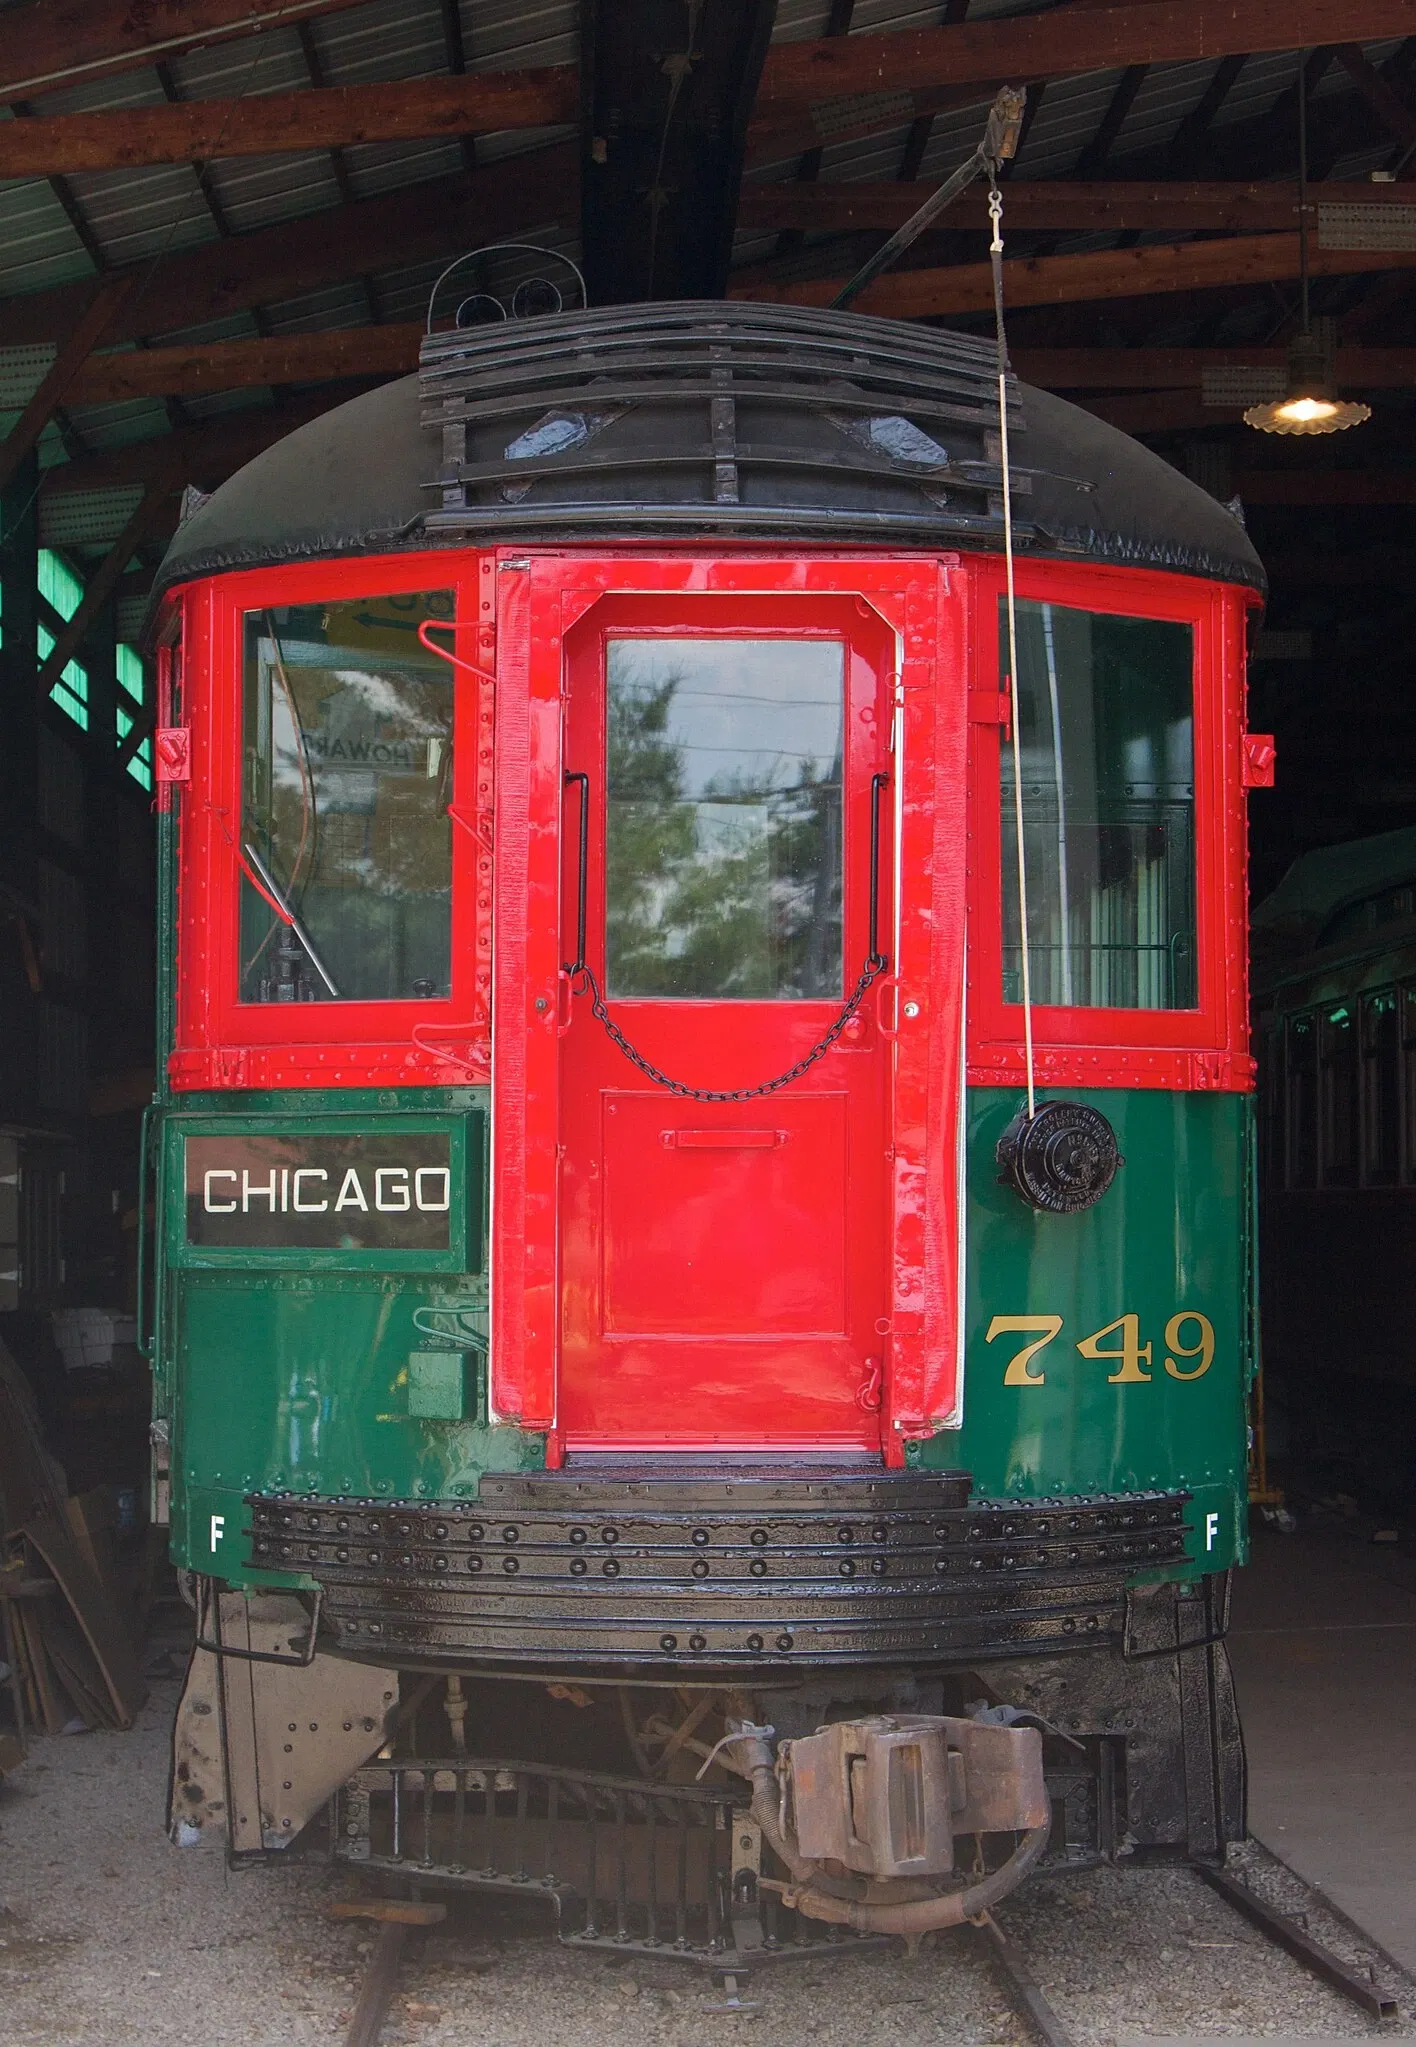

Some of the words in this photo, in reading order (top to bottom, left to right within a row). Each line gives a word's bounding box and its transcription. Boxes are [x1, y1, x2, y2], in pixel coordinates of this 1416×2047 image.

[204, 1167, 450, 1213] CHICAGO
[985, 1310, 1216, 1386] 749
[211, 1515, 225, 1553] F
[1206, 1512, 1218, 1551] F
